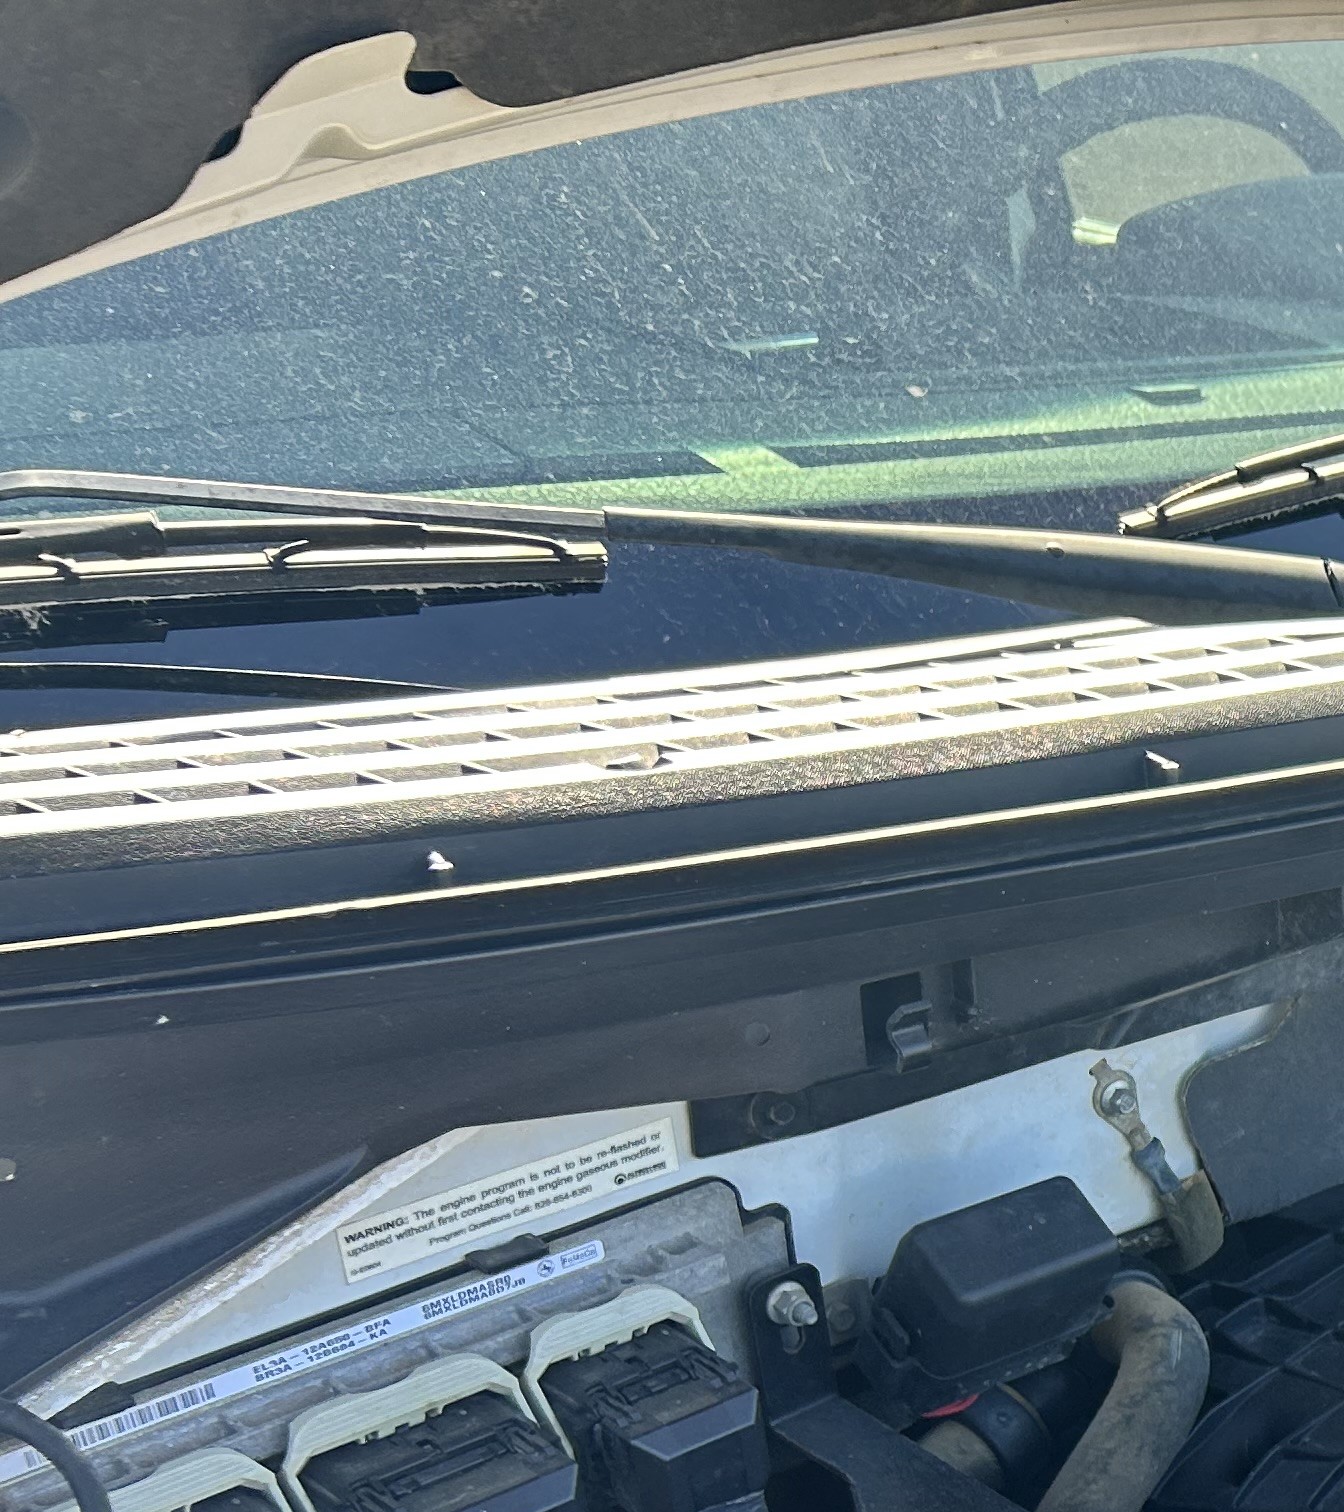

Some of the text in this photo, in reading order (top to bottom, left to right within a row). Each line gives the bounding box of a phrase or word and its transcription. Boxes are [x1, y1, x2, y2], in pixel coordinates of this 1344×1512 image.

[343, 1216, 409, 1244] WARNING:
[413, 1206, 436, 1220] The
[438, 1193, 477, 1213] engine
[479, 1175, 527, 1200] program
[541, 1164, 561, 1178] not
[577, 1153, 593, 1166] be
[345, 1234, 393, 1258] updated
[394, 1220, 435, 1240] without
[436, 1212, 459, 1226] first
[459, 1191, 516, 1219] contacting
[516, 1184, 535, 1199] the
[536, 1172, 575, 1194] engine
[574, 1158, 619, 1181] gaseous
